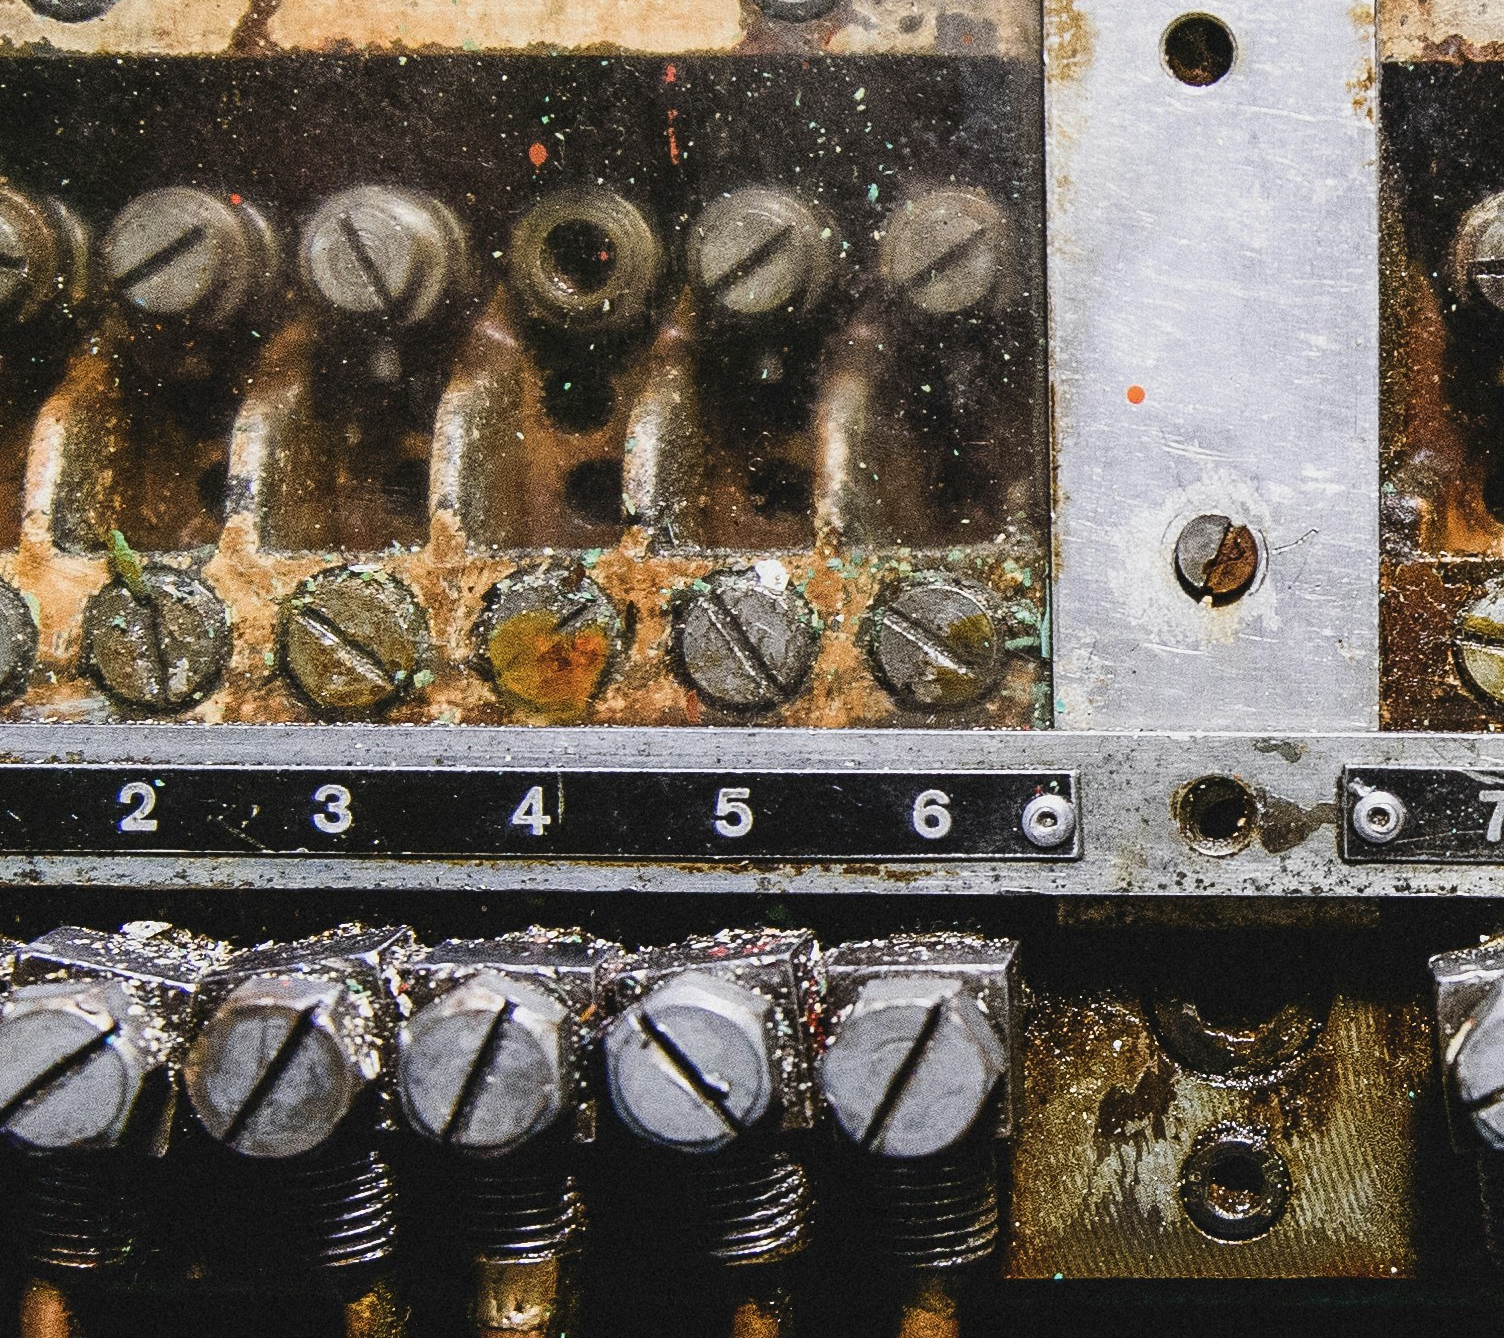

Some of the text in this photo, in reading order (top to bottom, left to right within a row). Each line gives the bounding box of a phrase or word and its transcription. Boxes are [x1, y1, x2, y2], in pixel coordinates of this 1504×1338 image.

[116, 780, 157, 833] 2
[312, 783, 354, 835] 3
[510, 784, 553, 837] 4
[710, 787, 754, 839] 5
[910, 787, 952, 840] 6
